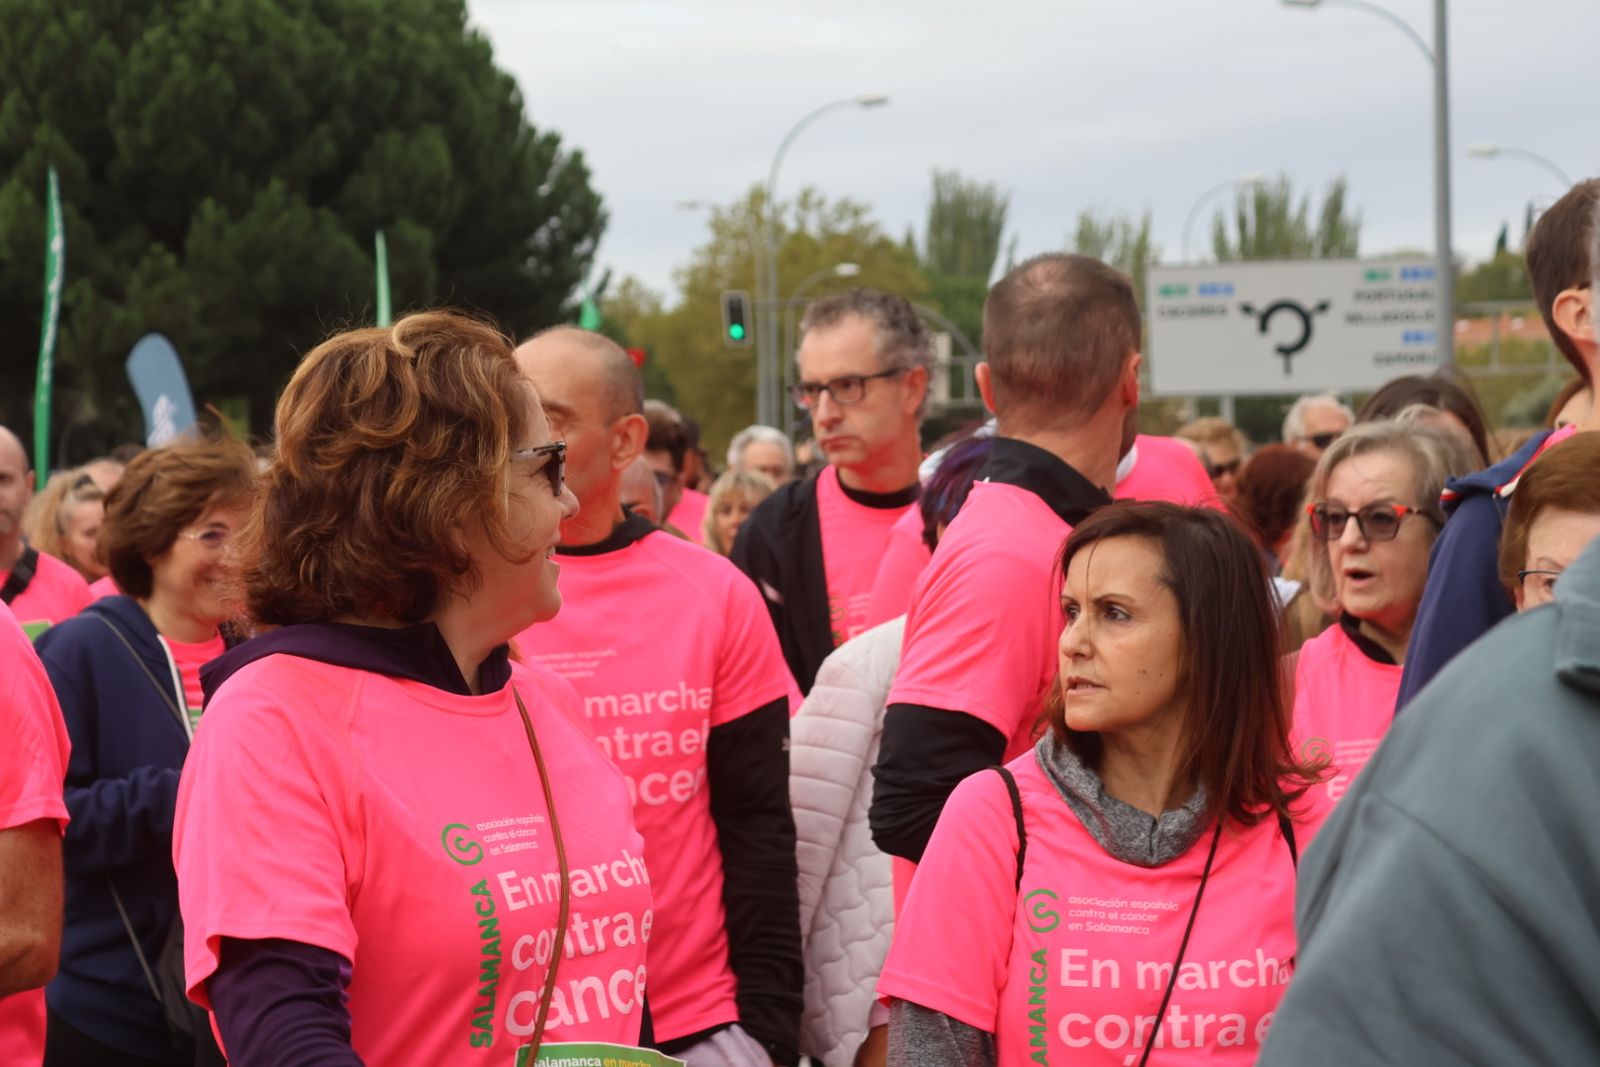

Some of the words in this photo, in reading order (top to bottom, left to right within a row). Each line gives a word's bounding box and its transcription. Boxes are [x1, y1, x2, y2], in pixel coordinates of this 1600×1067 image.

[584, 681, 713, 718] marcha
[596, 727, 673, 760] ntra
[1327, 775, 1348, 801] E
[497, 870, 543, 911] En
[542, 849, 649, 903] march
[1068, 896, 1128, 908] asociación
[1068, 909, 1106, 918] contra
[1107, 911, 1118, 920] el
[512, 912, 636, 971] contra
[641, 909, 654, 943] e
[1068, 922, 1083, 931] en
[1085, 921, 1150, 935] Salamanca
[470, 879, 501, 1047] SALAMANCA
[1060, 948, 1120, 989] En
[505, 965, 646, 1036] cánce
[1028, 948, 1048, 1067] AMANCA
[1058, 1004, 1246, 1050] contra
[1255, 1011, 1275, 1045] e
